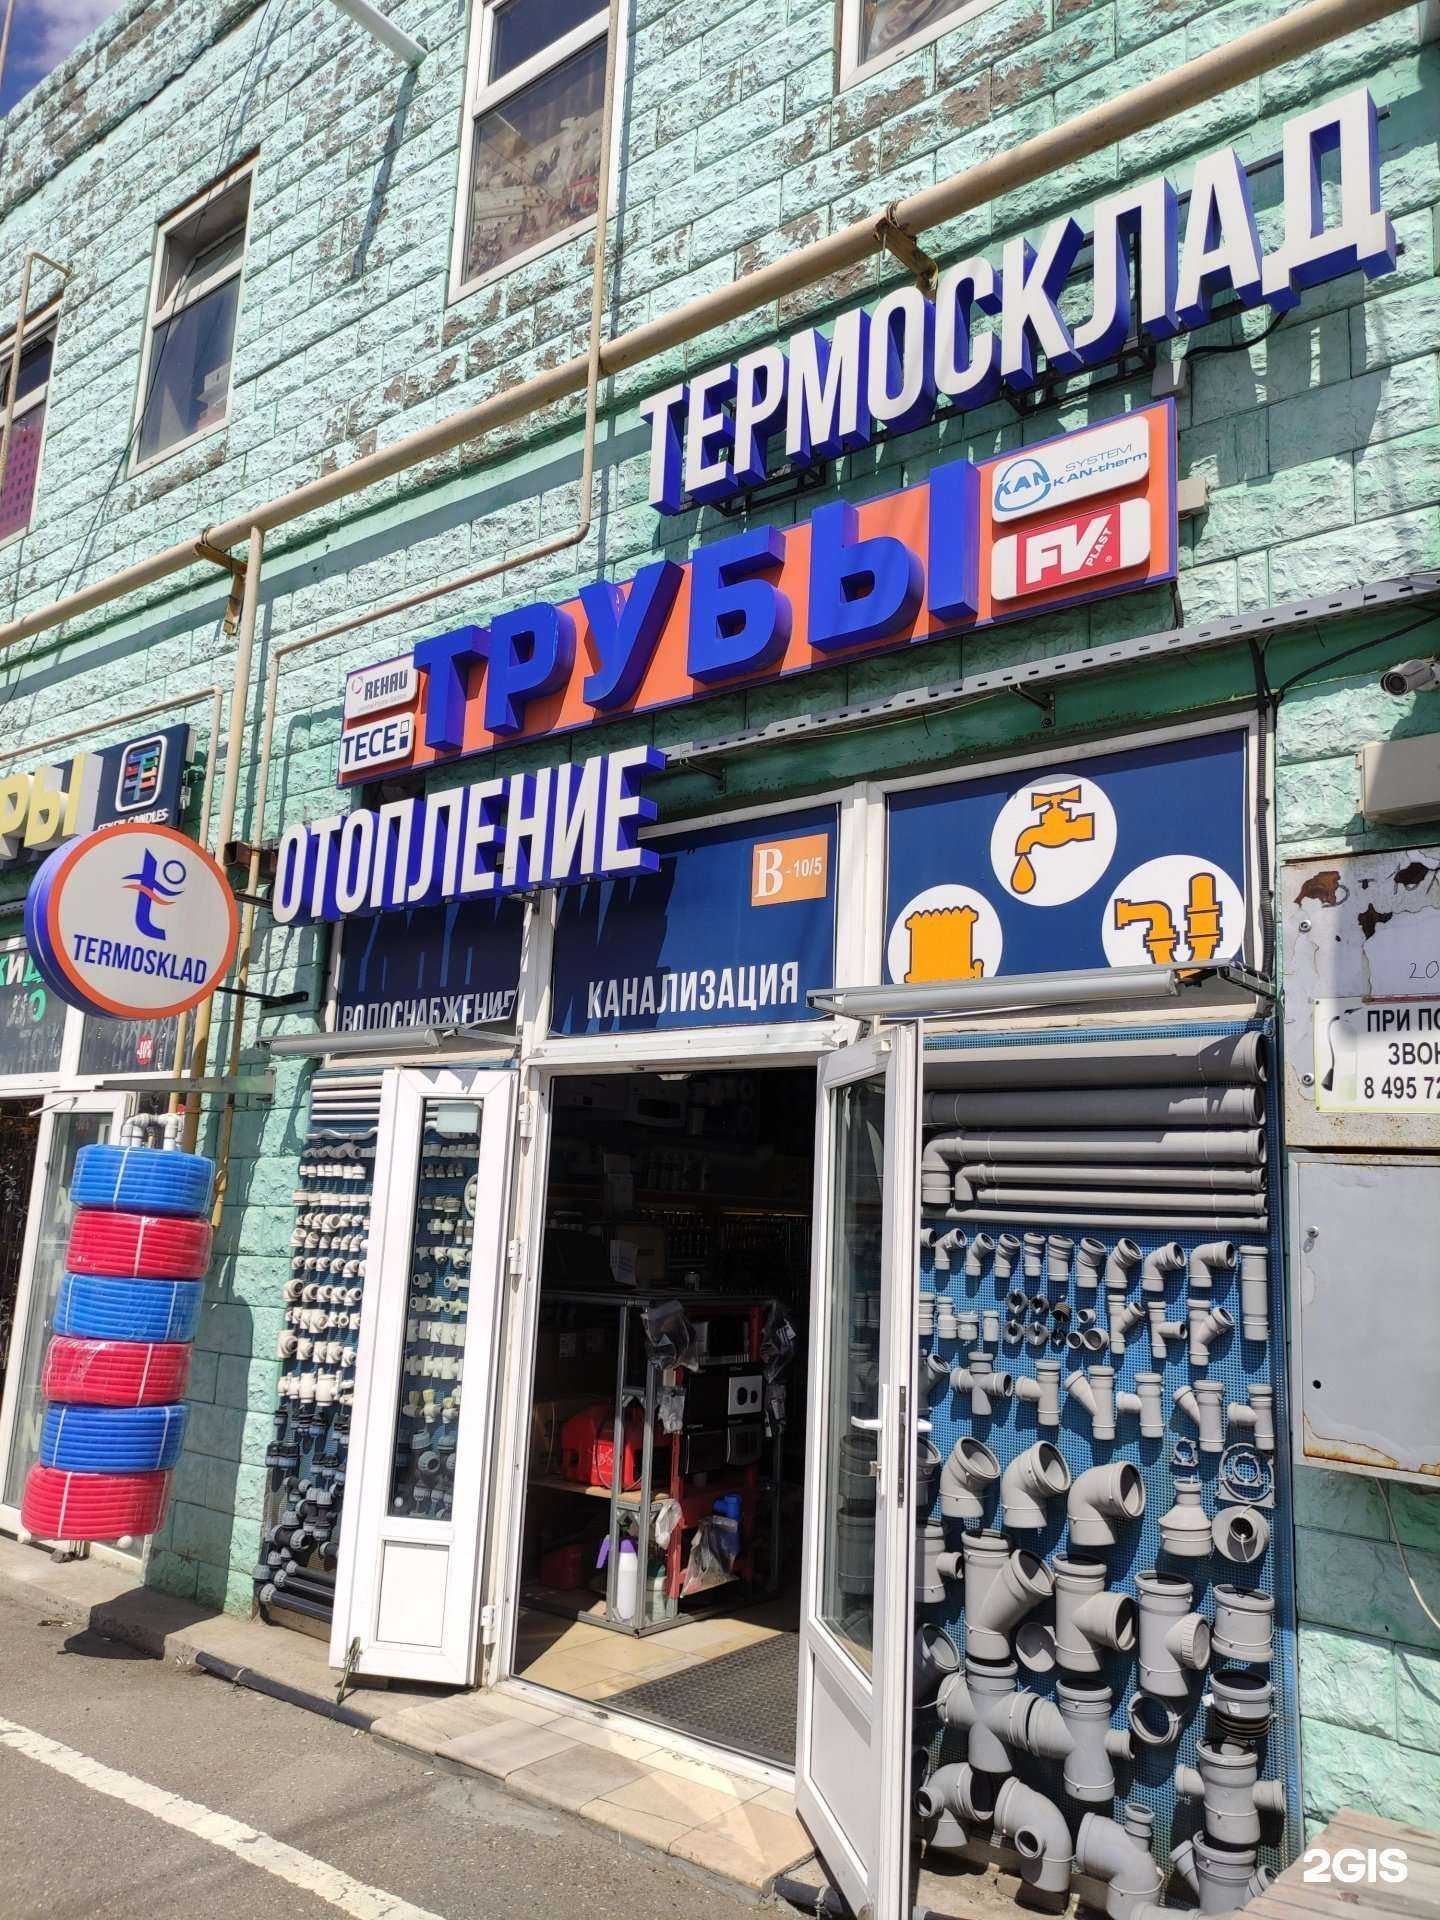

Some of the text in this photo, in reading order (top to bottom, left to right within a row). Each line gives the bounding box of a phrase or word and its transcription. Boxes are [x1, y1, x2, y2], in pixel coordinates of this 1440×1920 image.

[640, 88, 1395, 513] ТЕРМОСКЛАД
[1054, 452, 1147, 486] KAN-therm
[1066, 443, 1132, 472] SYSTEM
[999, 470, 1050, 495] KAN
[1026, 514, 1111, 584] FV
[1086, 528, 1112, 566] PLAST
[414, 460, 979, 750] ТРУБЫ
[364, 670, 408, 701] REHAU
[342, 723, 398, 765] TECE
[272, 745, 655, 924] ОТОПЛЕНИЕ
[74, 934, 207, 985] TERMOSKLAD
[587, 962, 799, 1019] КАНАЛИЗАЦИЯ
[1367, 1009, 1410, 1032] ПРИ
[1364, 1077, 1375, 1099] 8
[1381, 1076, 1417, 1099] 495
